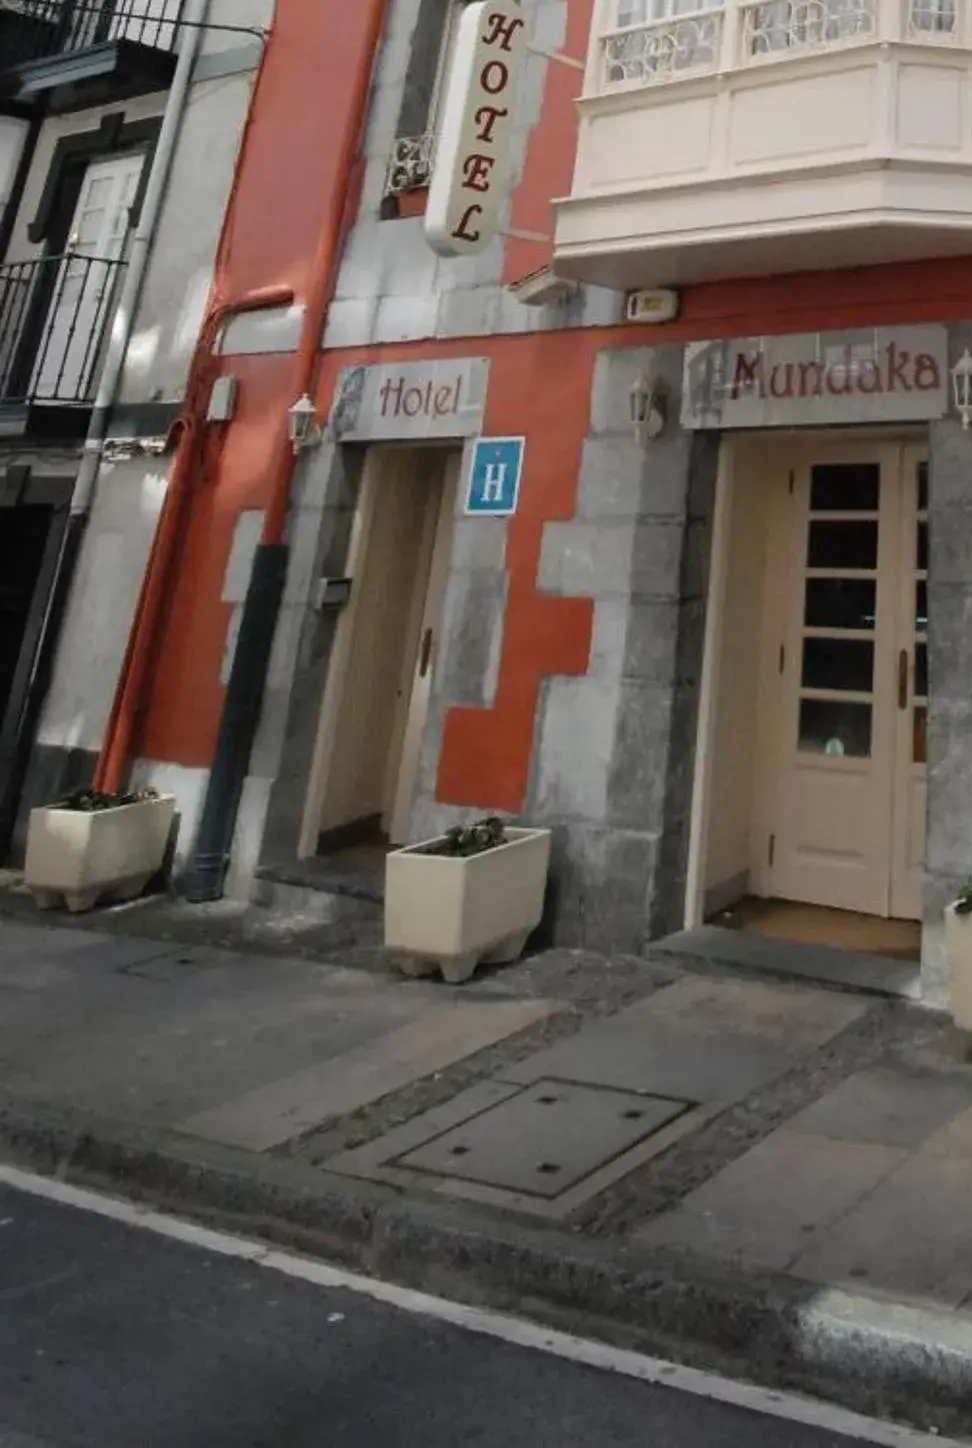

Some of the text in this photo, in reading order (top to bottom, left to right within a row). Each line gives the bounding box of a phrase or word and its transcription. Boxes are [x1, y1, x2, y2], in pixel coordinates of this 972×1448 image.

[451, 12, 524, 243] HOTEL
[380, 374, 463, 418] Hotel
[731, 340, 940, 400] Mundaka
[480, 462, 507, 502] H
